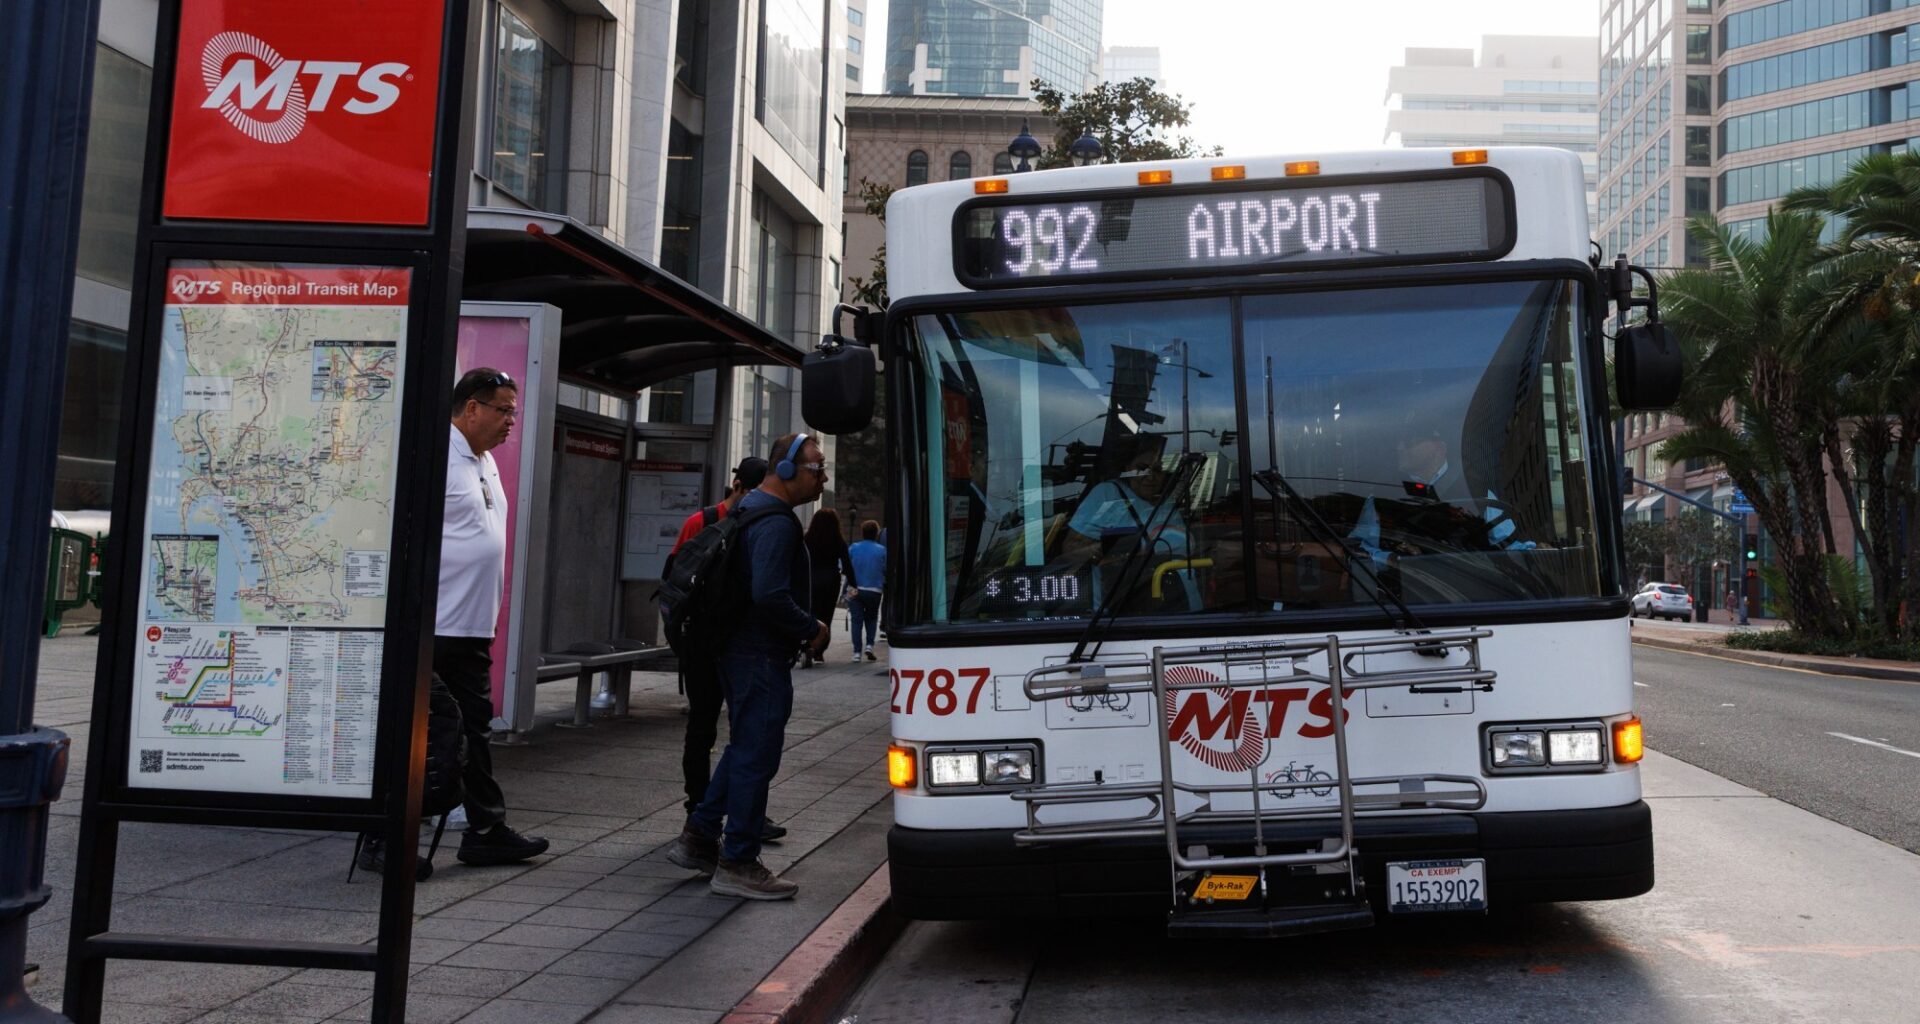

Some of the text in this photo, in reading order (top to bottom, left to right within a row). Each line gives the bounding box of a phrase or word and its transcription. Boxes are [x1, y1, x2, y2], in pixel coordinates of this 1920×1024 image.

[200, 59, 410, 115] MTS
[1002, 193, 1381, 274] 992 AIRPORT
[172, 280, 398, 299] MTS Regional Transit Map
[986, 575, 1078, 602] $ 3.00
[890, 667, 991, 716] 2787
[1168, 687, 1356, 742] MTS
[166, 763, 205, 771] sdmts.com
[1207, 881, 1244, 891] Byk-Rak
[1411, 867, 1462, 878] CA EXEMPT
[1396, 878, 1480, 905] 1553902
